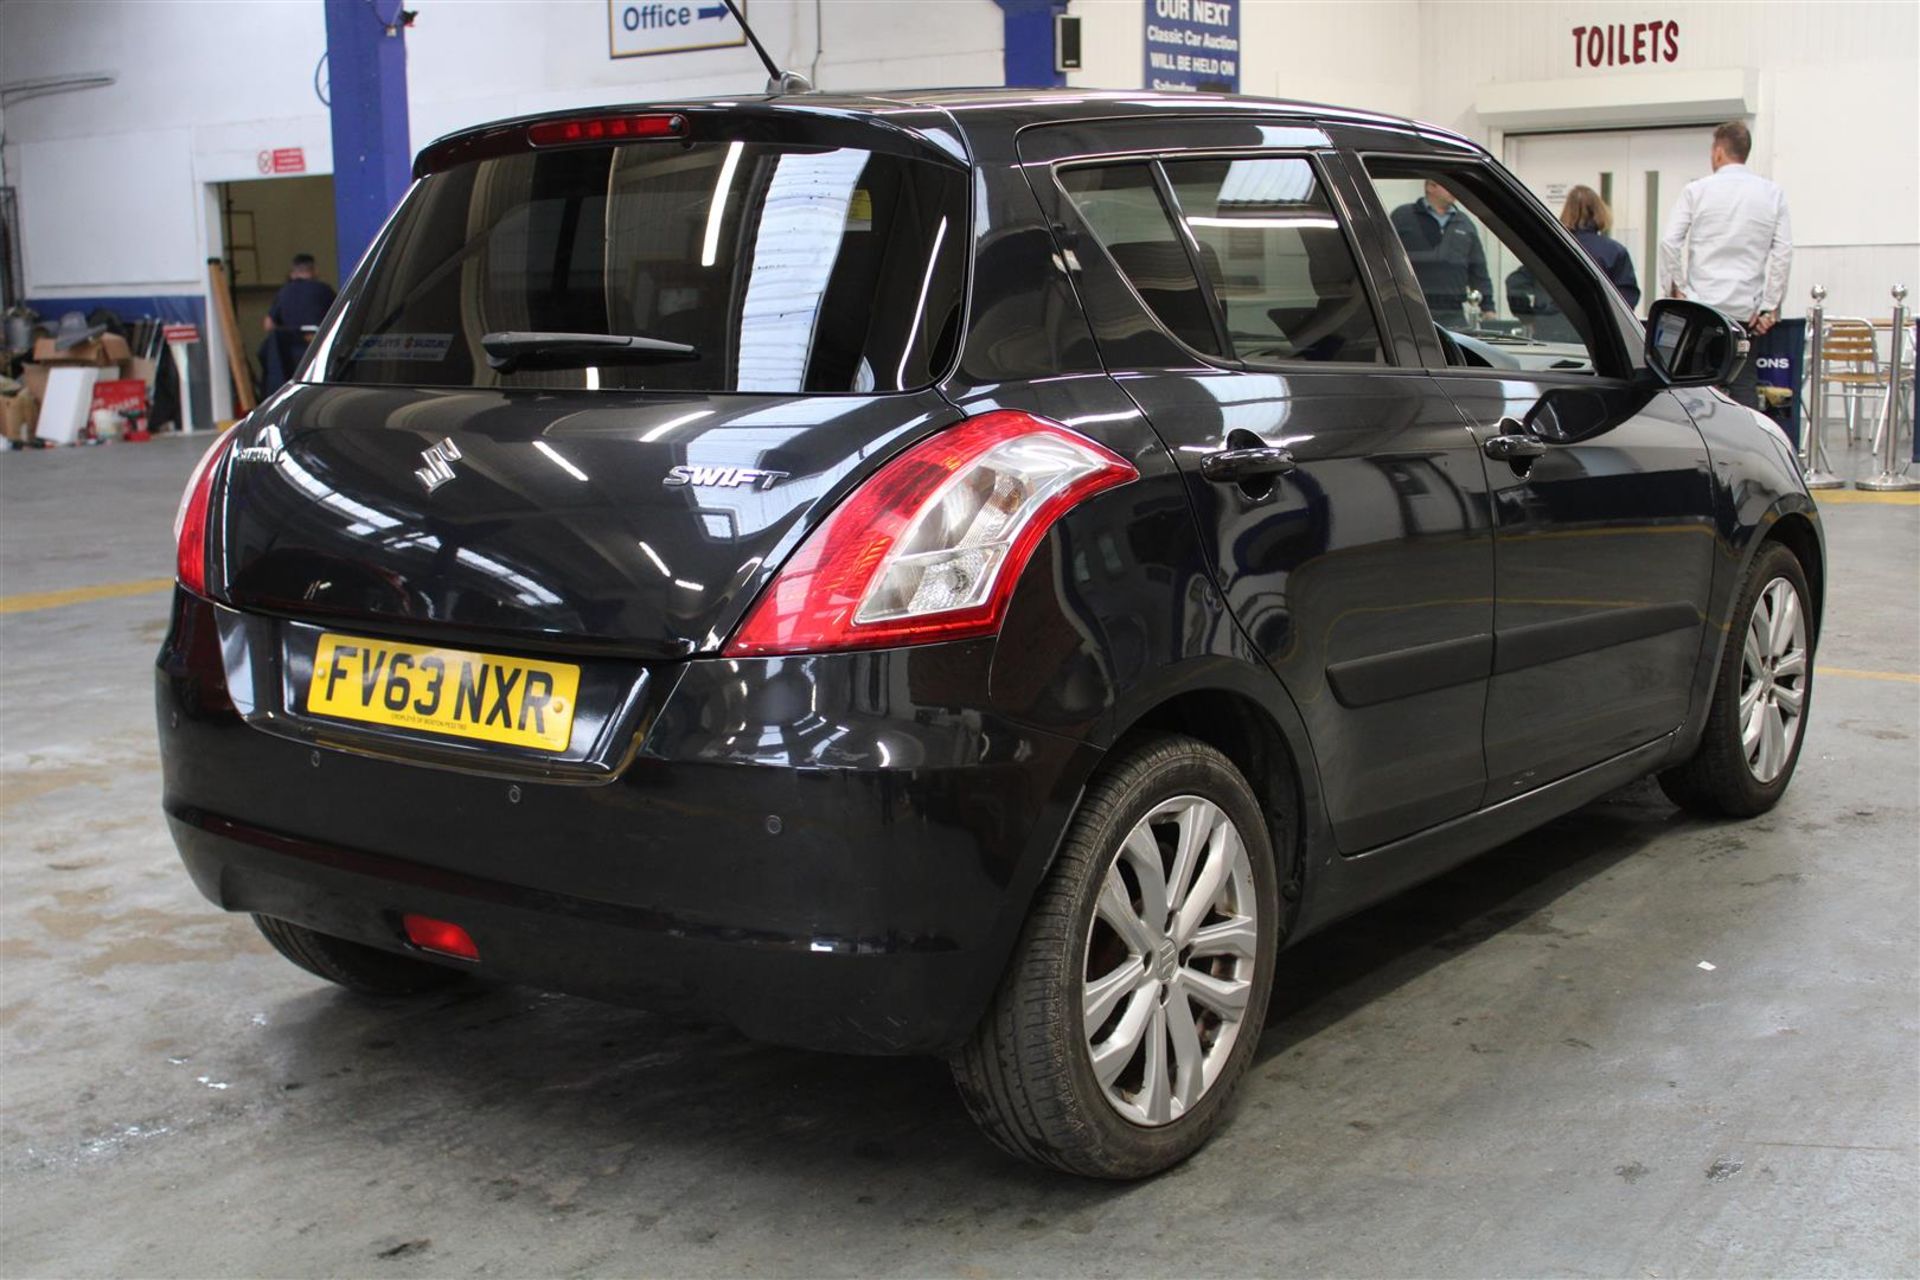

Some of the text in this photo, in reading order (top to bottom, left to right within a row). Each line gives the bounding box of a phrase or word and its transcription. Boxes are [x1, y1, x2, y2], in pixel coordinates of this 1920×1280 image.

[623, 4, 690, 31] Office
[1156, 0, 1231, 27] OUR NEXT
[1147, 25, 1238, 51] Classic Car Auction
[1572, 20, 1679, 67] TOILETS
[1150, 52, 1236, 77] WILL BE HELD ON
[663, 465, 790, 491] SWIFT
[326, 645, 553, 734] FV63 NXR
